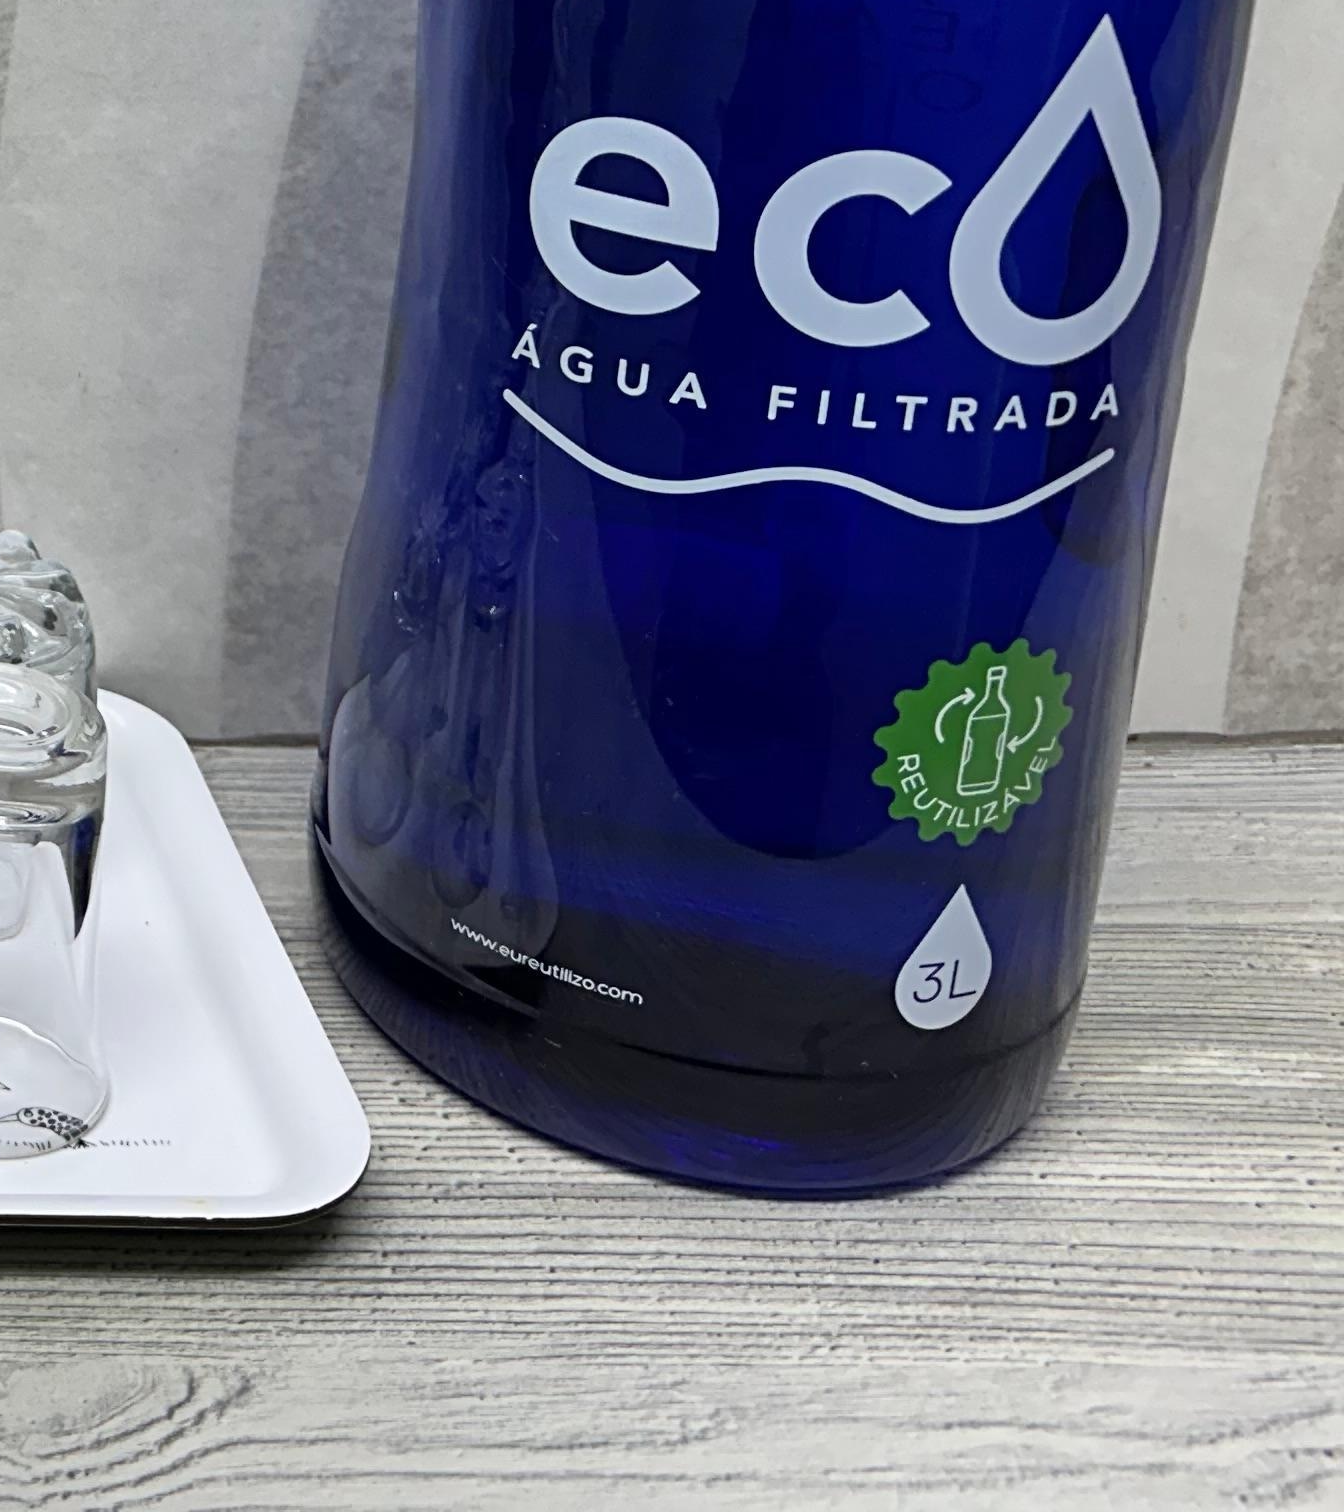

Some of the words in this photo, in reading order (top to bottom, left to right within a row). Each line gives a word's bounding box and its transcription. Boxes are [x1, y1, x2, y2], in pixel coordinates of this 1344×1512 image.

[529, 14, 1162, 366] eco
[511, 323, 708, 410] ÁGUA
[767, 383, 1119, 432] FILTRADA
[450, 918, 643, 1005] www.eureutilizo.com
[912, 960, 976, 1003] 3L
